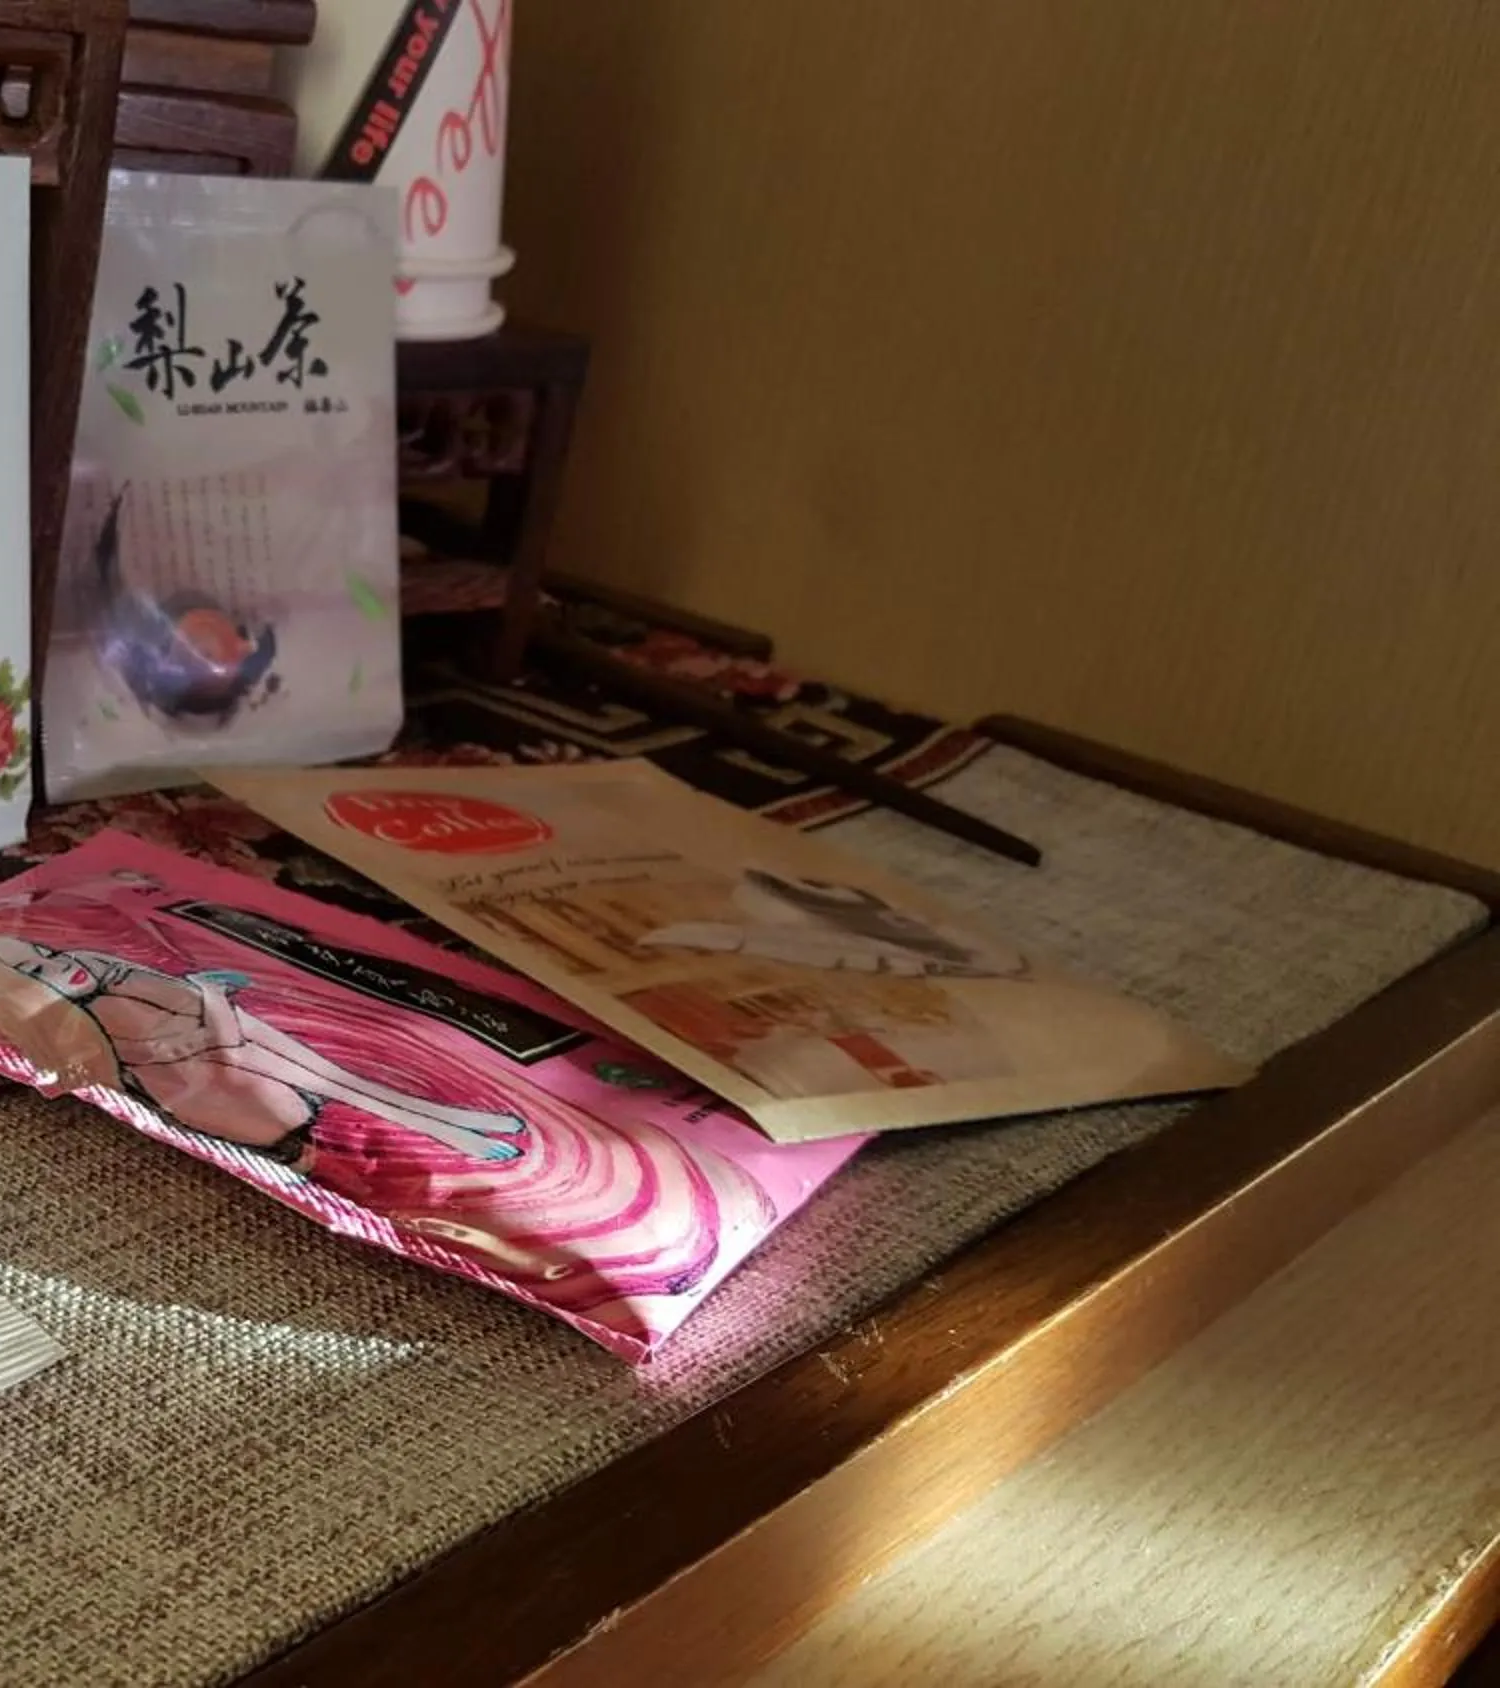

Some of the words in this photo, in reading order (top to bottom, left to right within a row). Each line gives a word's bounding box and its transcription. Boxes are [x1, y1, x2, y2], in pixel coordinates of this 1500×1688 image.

[387, 7, 440, 99] your
[351, 98, 400, 167] life
[123, 275, 329, 401] 梨山茶
